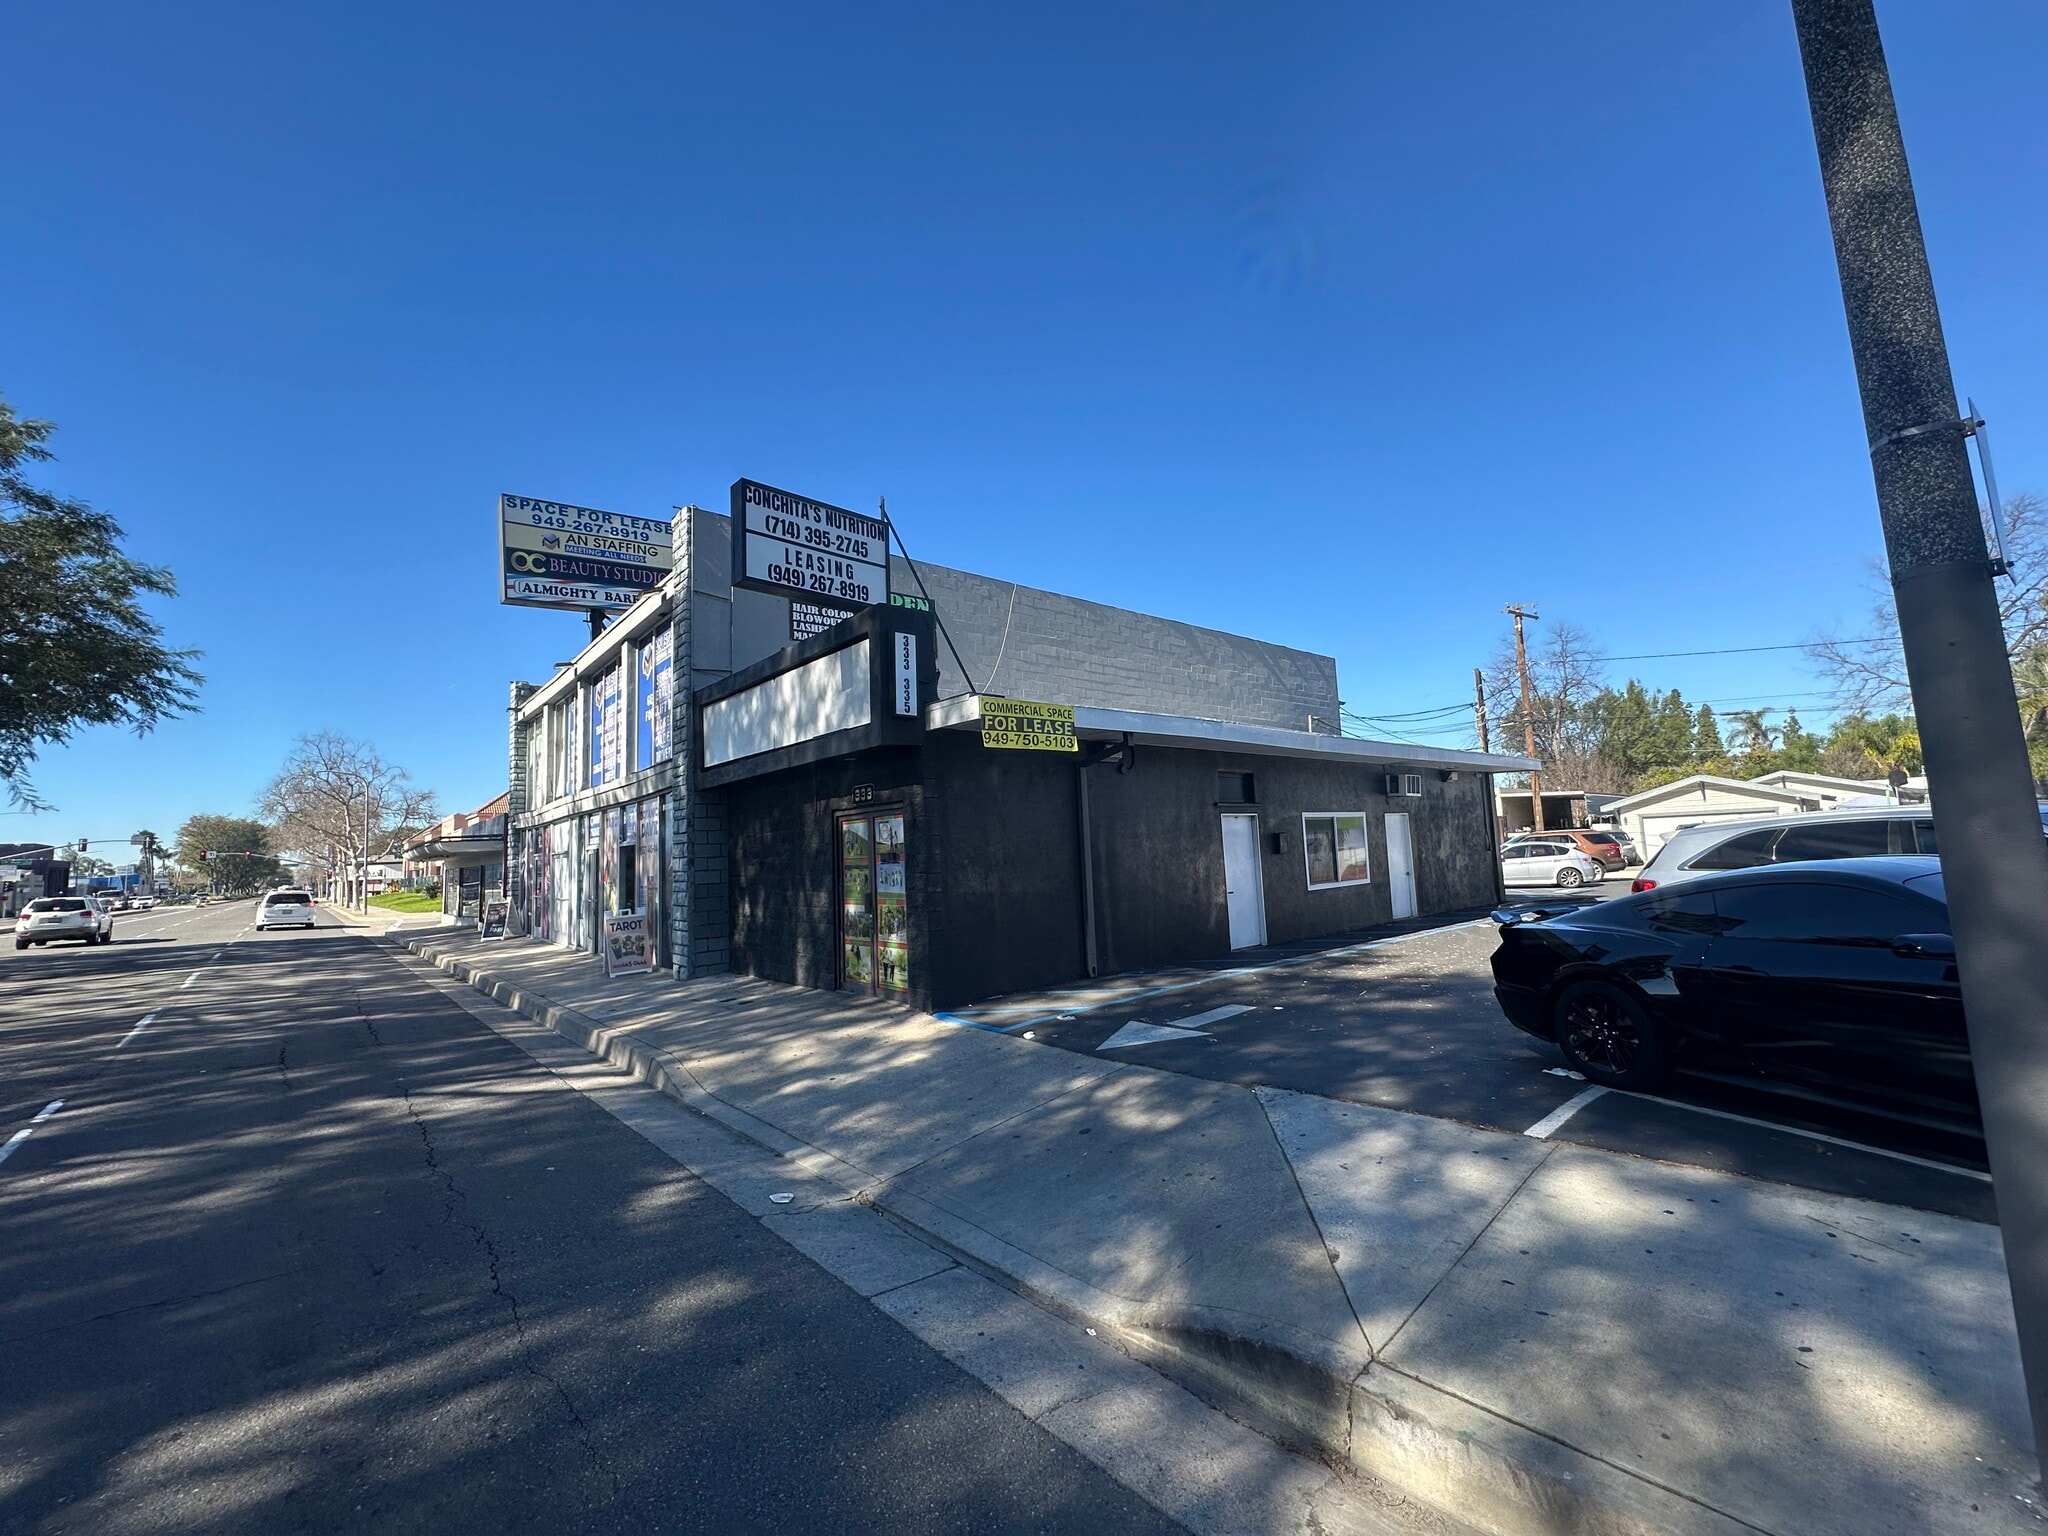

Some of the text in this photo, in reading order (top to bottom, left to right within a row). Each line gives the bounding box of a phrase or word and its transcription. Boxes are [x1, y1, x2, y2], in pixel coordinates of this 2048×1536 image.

[506, 497, 673, 535] SPACE FOR LEASE
[745, 486, 886, 542] CONCHITA'S NUTRITION
[532, 514, 650, 542] 949-267-8919
[765, 515, 868, 558] (714) 395-2745
[566, 545, 645, 563] MEETING ALL NEEDS
[593, 537, 659, 557] STAFFING
[511, 551, 546, 574] OC
[550, 558, 611, 578] BEAUTY
[785, 547, 854, 580] LEASING
[523, 582, 598, 600] ALMIGHTY
[767, 563, 870, 602] (949) 267-8919
[792, 603, 819, 614] HAIR
[890, 593, 930, 611] DEN
[983, 701, 1073, 720] COMMERCIAL SPACE
[984, 716, 1073, 735] FOR LEASE
[983, 732, 1075, 749] 949-750-5103
[609, 920, 643, 932] TAROT
